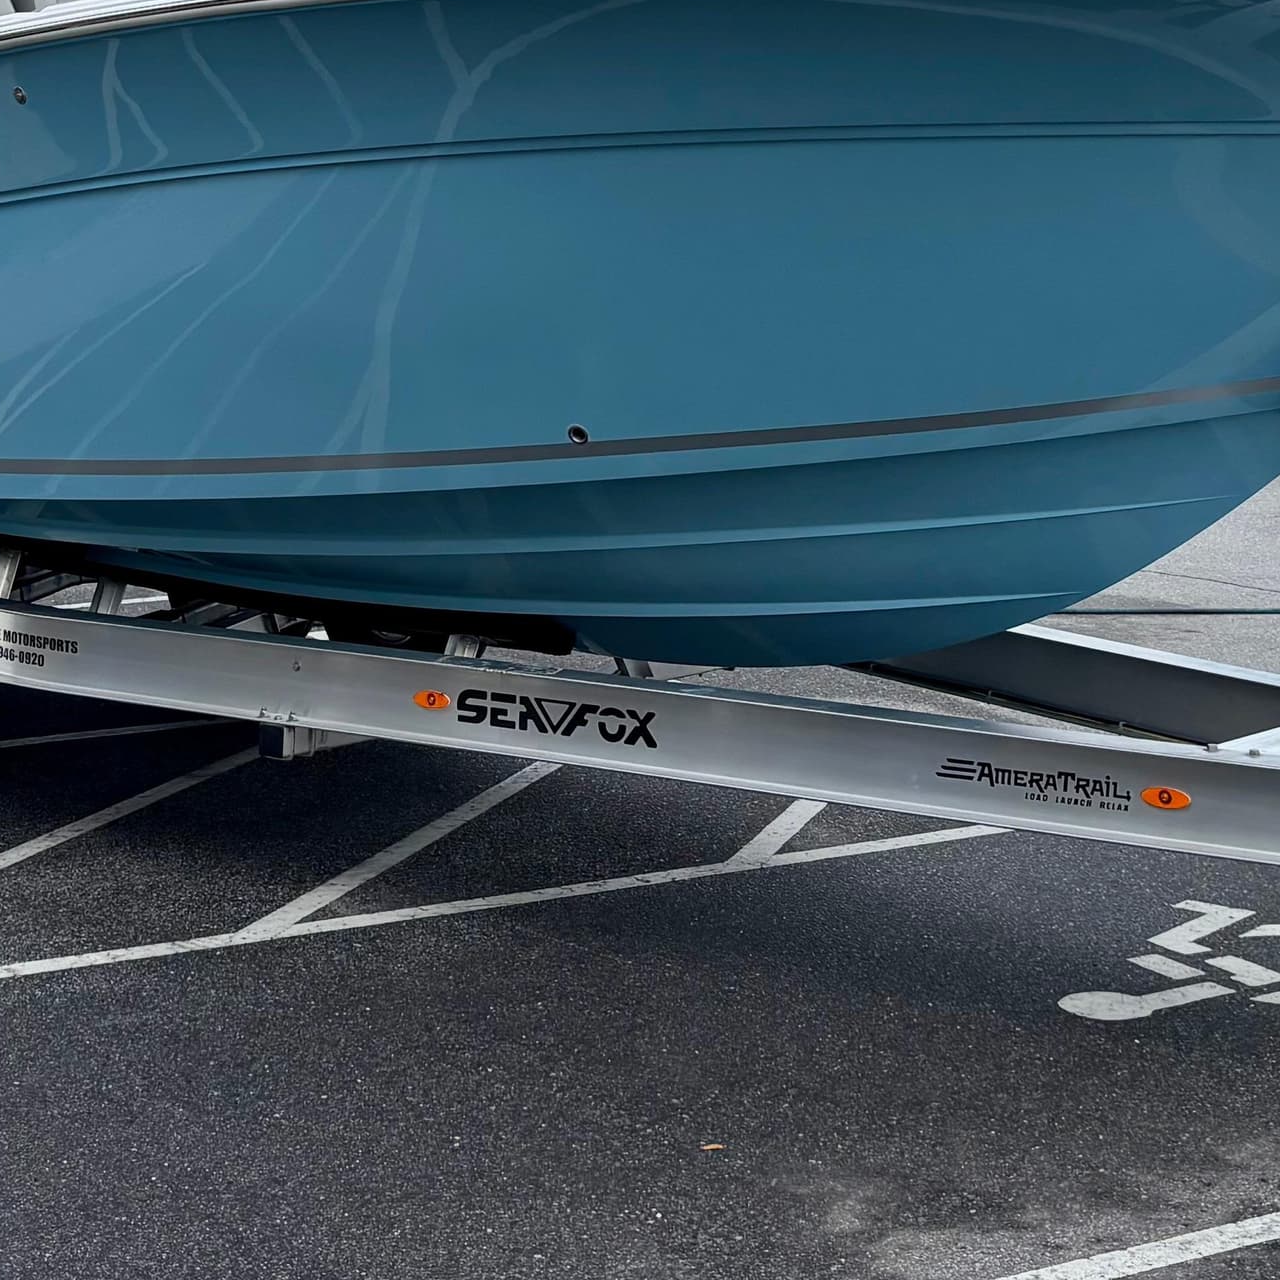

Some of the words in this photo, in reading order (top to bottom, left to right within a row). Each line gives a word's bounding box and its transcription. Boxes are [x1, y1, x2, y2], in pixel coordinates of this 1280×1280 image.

[3, 629, 78, 654] MOTORSPORTS
[1024, 791, 1049, 803] LOAD
[1055, 796, 1093, 808] LAUNCH
[1099, 801, 1130, 812] RELAX
